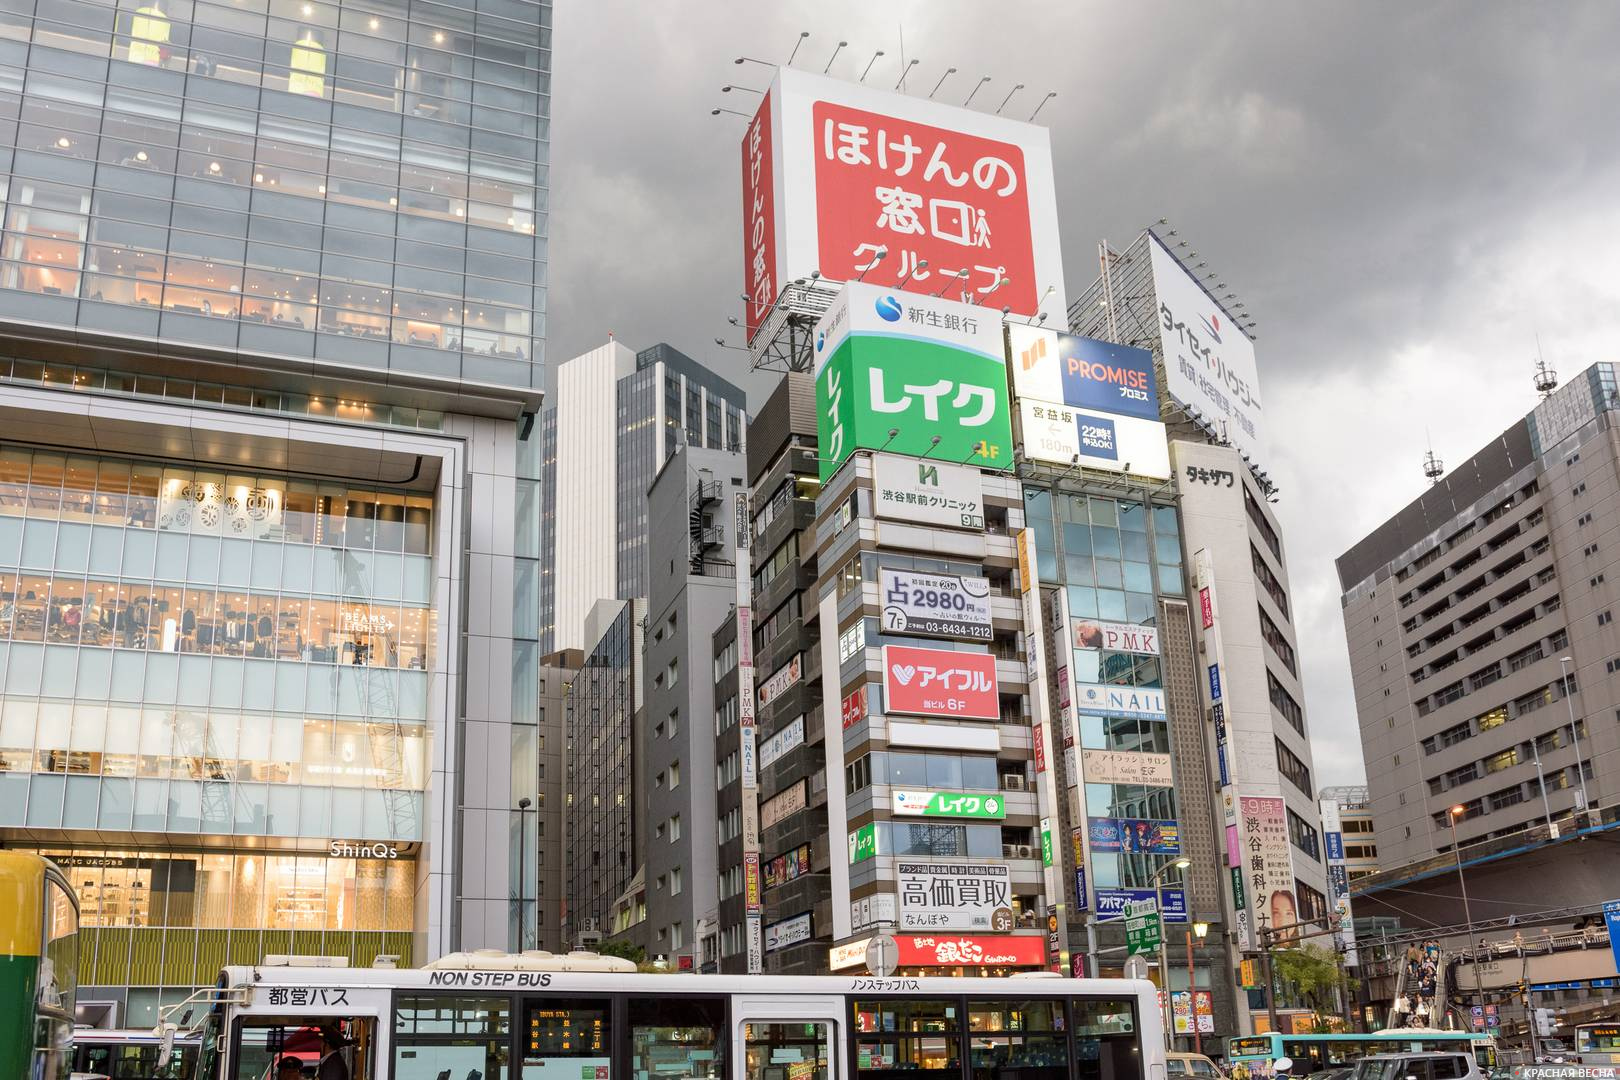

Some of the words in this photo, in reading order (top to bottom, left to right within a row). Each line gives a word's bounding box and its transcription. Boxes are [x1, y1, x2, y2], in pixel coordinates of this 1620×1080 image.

[823, 118, 1018, 198] ほけんの
[852, 243, 1010, 294] グループ
[908, 306, 978, 335] 新生銀行
[1160, 301, 1262, 411] タイセイ・ハウジー
[1067, 357, 1149, 391] PROMISE
[869, 366, 996, 427] レイク
[1119, 386, 1150, 402] プロミス
[827, 366, 843, 465] レイク
[1033, 406, 1073, 424] 宮益坂
[1040, 438, 1073, 454] 180m
[1186, 465, 1235, 488] タキザワ
[882, 488, 977, 513] 渋谷駅前クリニック
[887, 576, 909, 605] 占
[913, 589, 975, 613] 2980円
[344, 623, 386, 634] LIGHTS
[345, 612, 386, 624] BEAMS
[887, 612, 903, 629] 7F
[926, 621, 991, 638] 03-6434-1212
[1105, 630, 1156, 652] PMK
[769, 671, 788, 700] PMK
[917, 665, 992, 693] アイフル
[742, 688, 752, 717] PMK
[947, 698, 966, 712] 6F
[1110, 692, 1165, 712] NAIL
[744, 744, 753, 773] NAIL
[1034, 726, 1044, 770] アイフル
[938, 795, 980, 814] レイク
[330, 841, 397, 859] ShinQs
[858, 837, 872, 853] レイク
[1043, 836, 1051, 864] レイク
[57, 858, 82, 866] MARC
[900, 864, 928, 874] ブランド品
[951, 866, 966, 875] 時計
[900, 876, 1009, 908] 高価買取
[905, 913, 950, 926] なんぼや
[997, 917, 1012, 931] 3F
[1050, 932, 1058, 942] 2F
[935, 938, 983, 963] 銀だこ
[429, 972, 468, 986] NON
[471, 972, 515, 986] STEP
[516, 973, 552, 987] BUS
[850, 979, 920, 992] ノンステップバス
[269, 987, 350, 1007] 都営バス
